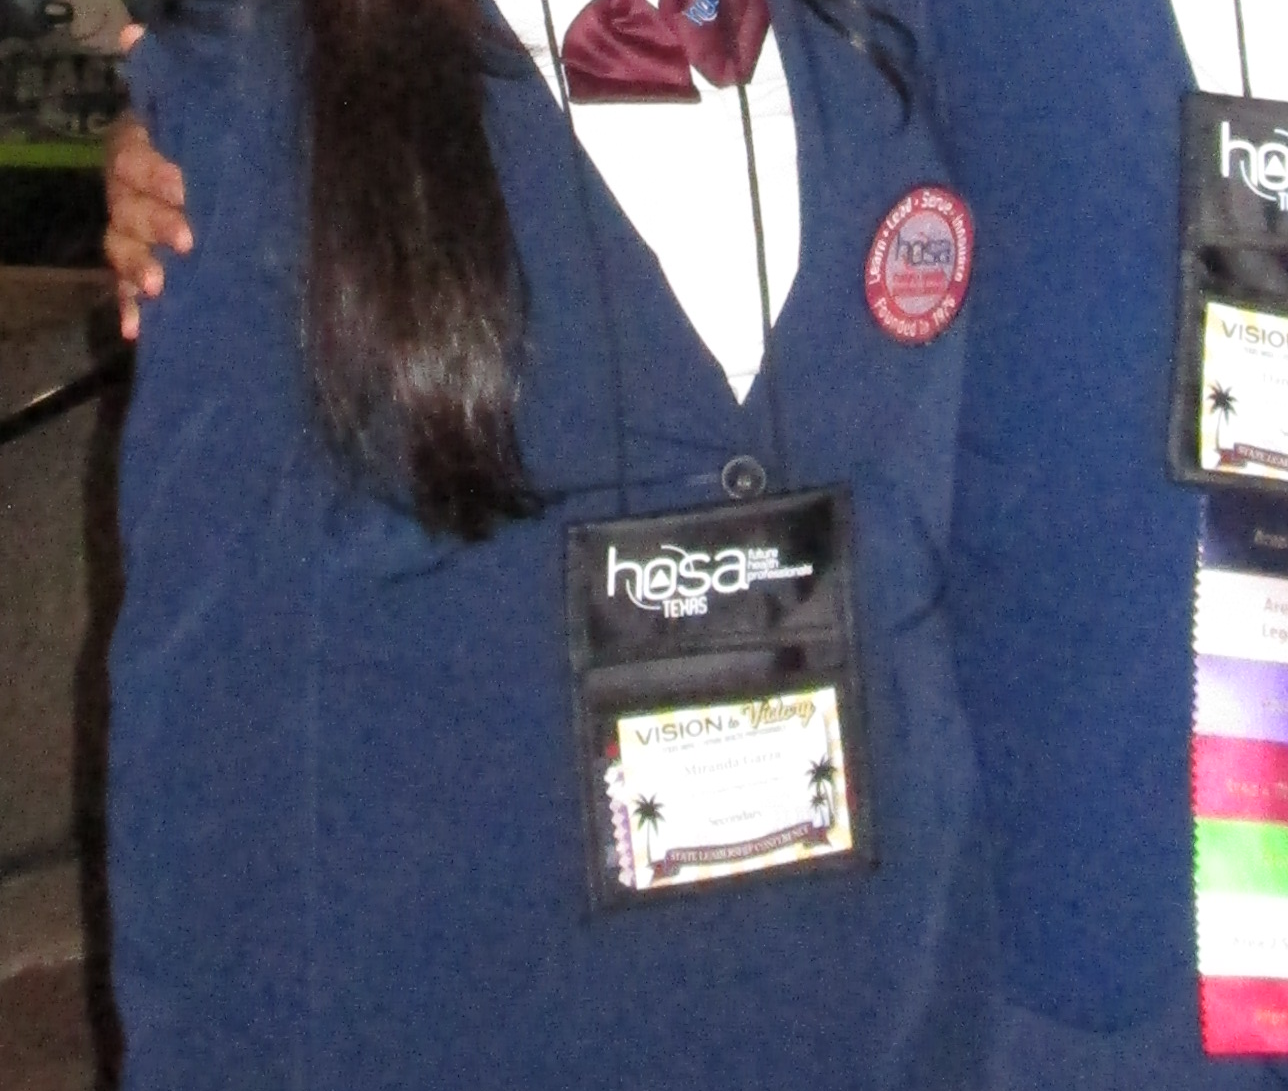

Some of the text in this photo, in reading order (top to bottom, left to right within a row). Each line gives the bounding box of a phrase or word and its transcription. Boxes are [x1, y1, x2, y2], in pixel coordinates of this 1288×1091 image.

[868, 239, 888, 285] Learn
[886, 196, 913, 230] Lead
[920, 190, 953, 215] Serve
[748, 547, 779, 560] future
[748, 557, 779, 571] health
[606, 545, 750, 601] hosa
[748, 564, 814, 582] professionals
[662, 595, 709, 619] TEXAS
[635, 715, 723, 746] VISION
[727, 716, 740, 729] to
[740, 697, 816, 729] Victory
